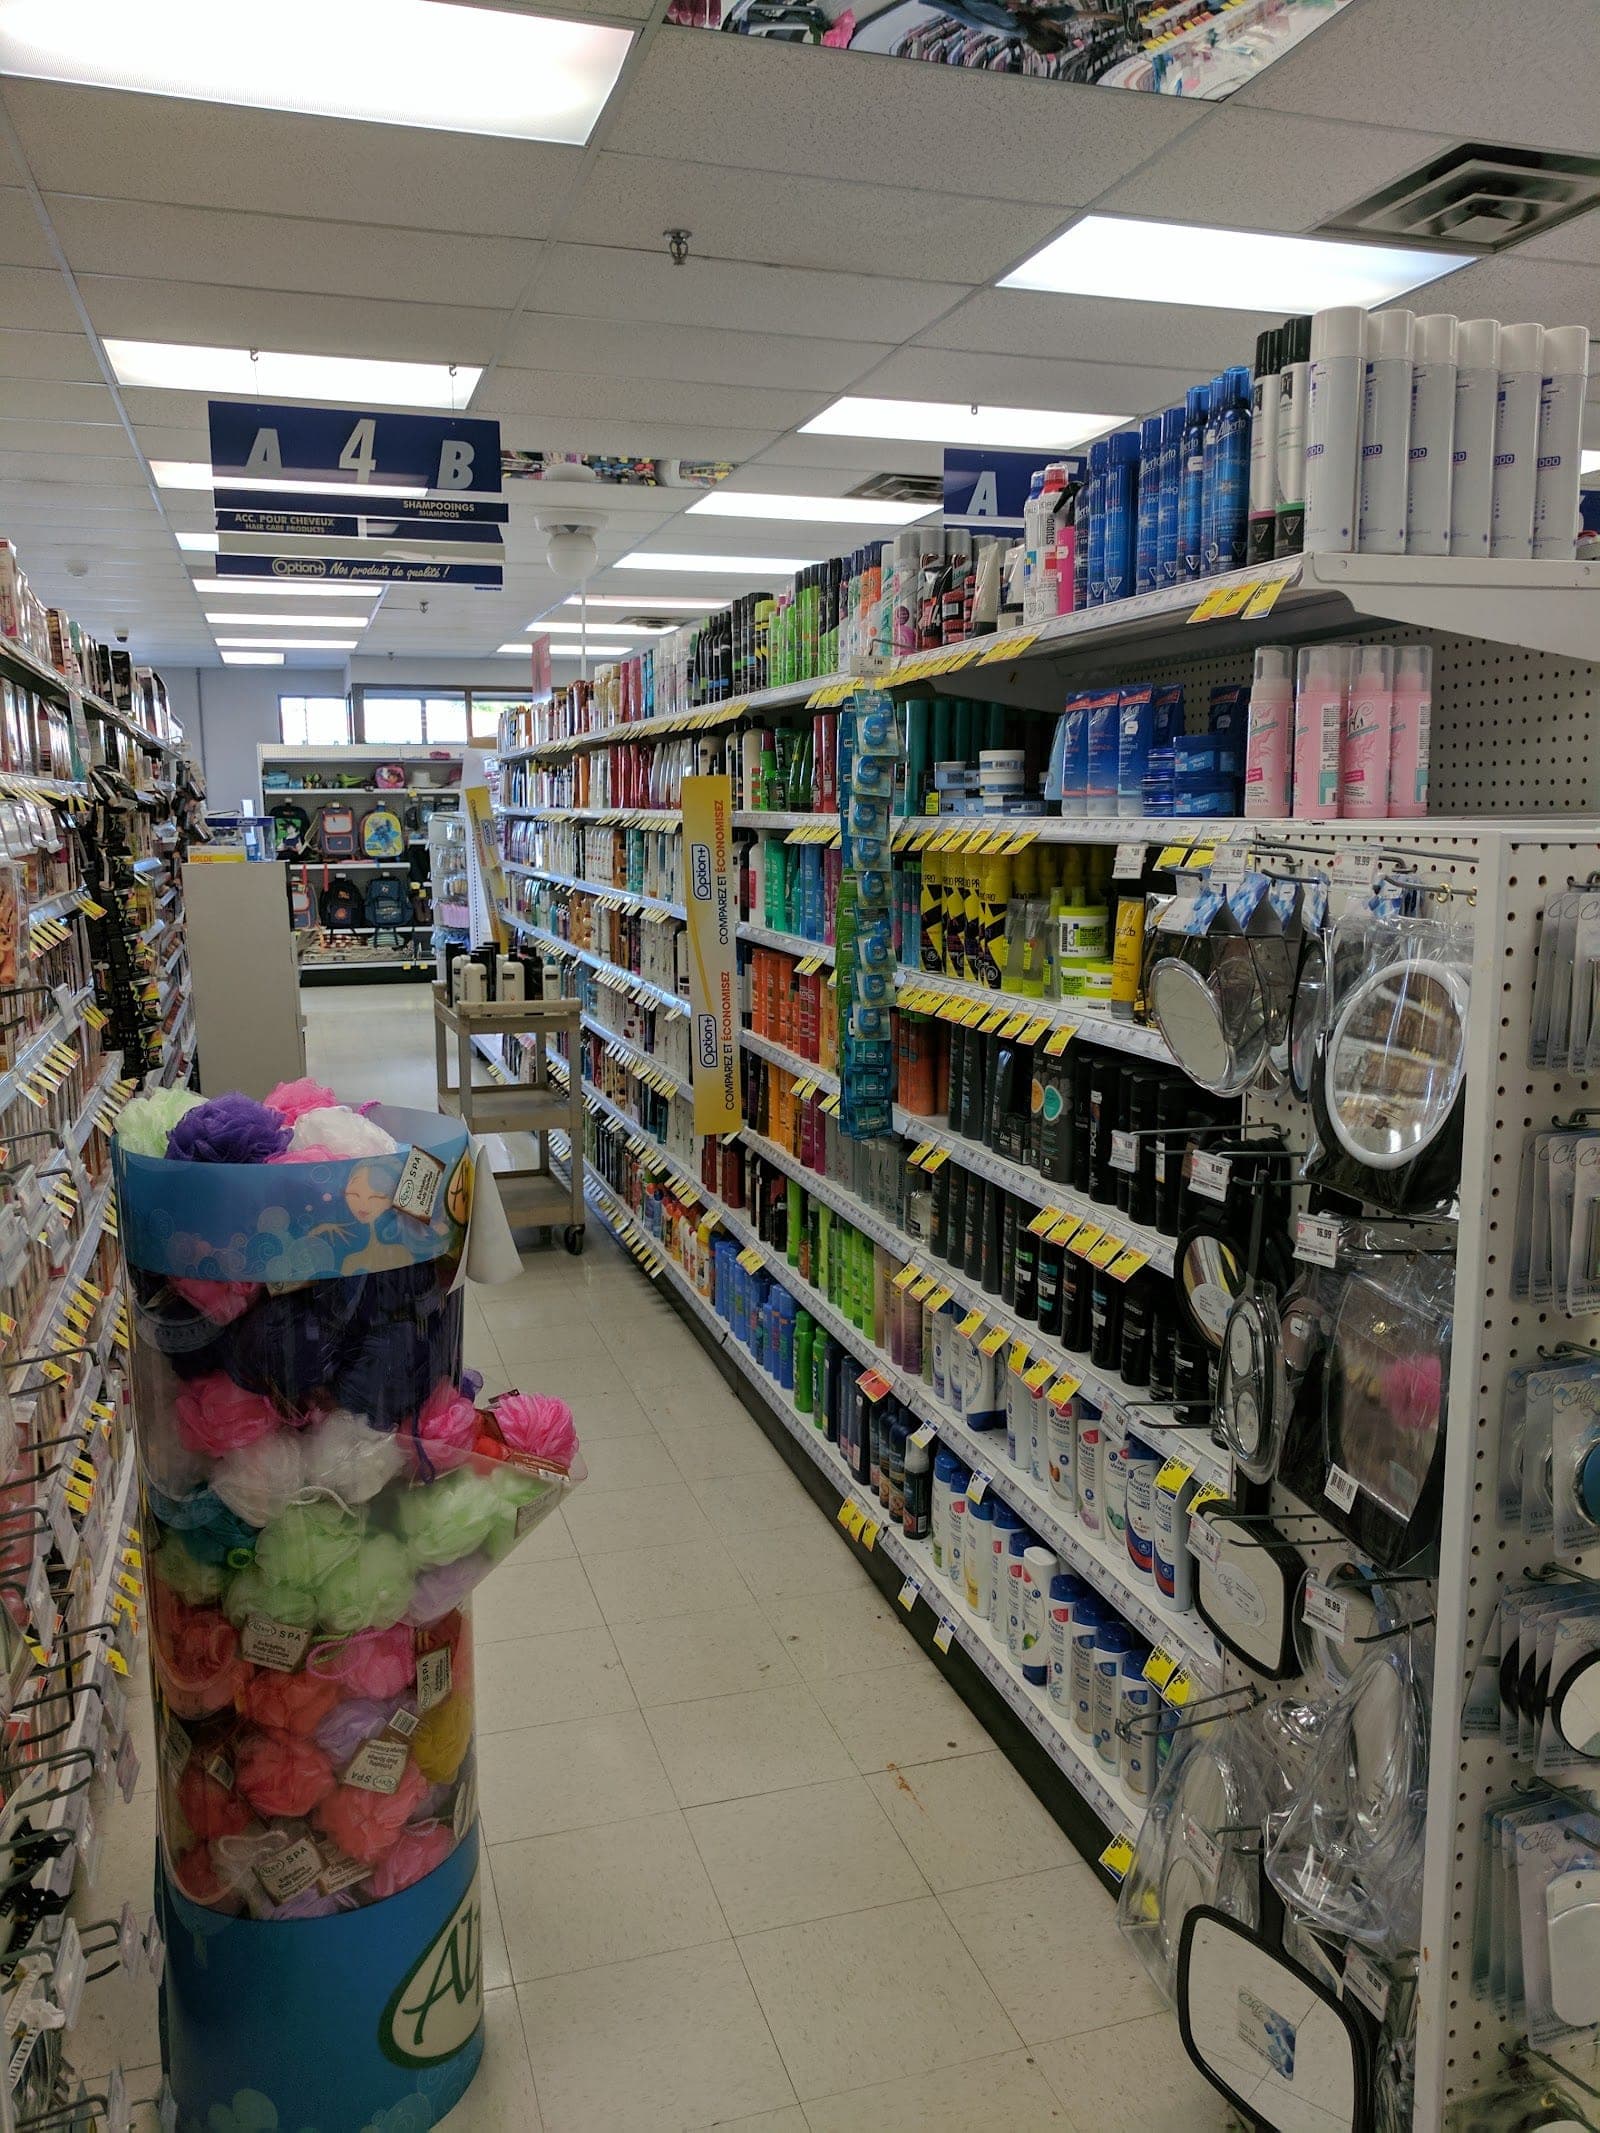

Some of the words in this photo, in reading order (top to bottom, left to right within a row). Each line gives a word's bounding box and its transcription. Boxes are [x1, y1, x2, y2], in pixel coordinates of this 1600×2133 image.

[245, 428, 282, 472] A
[338, 418, 376, 484] 4
[436, 440, 475, 490] B
[966, 471, 998, 516] A
[403, 500, 475, 512] SHAMPOOINGS
[418, 510, 460, 518] SHAMPOOS
[234, 513, 257, 523] ACC.
[259, 514, 288, 525] POUR
[290, 516, 335, 526] CHEVEUX
[286, 524, 325, 534] PRODUCTS
[1047, 519, 1055, 545] STUDIO
[330, 564, 348, 576] Nos
[349, 564, 389, 578] produits
[391, 566, 404, 577] de
[406, 566, 440, 580] qualité
[715, 800, 726, 873] ÉCONOMISEZ
[696, 847, 710, 897] Option+
[717, 876, 727, 887] ET
[717, 888, 728, 945] COMPAREZ
[721, 971, 732, 1041] ÉCONOMISEZ
[703, 1017, 715, 1065] Option+
[724, 1044, 733, 1053] ET
[724, 1054, 734, 1110] COMPAREZ
[410, 1157, 421, 1177] SPA
[279, 1630, 301, 1641] SPA
[352, 1771, 371, 1783] SPA
[286, 1846, 308, 1864] SPA
